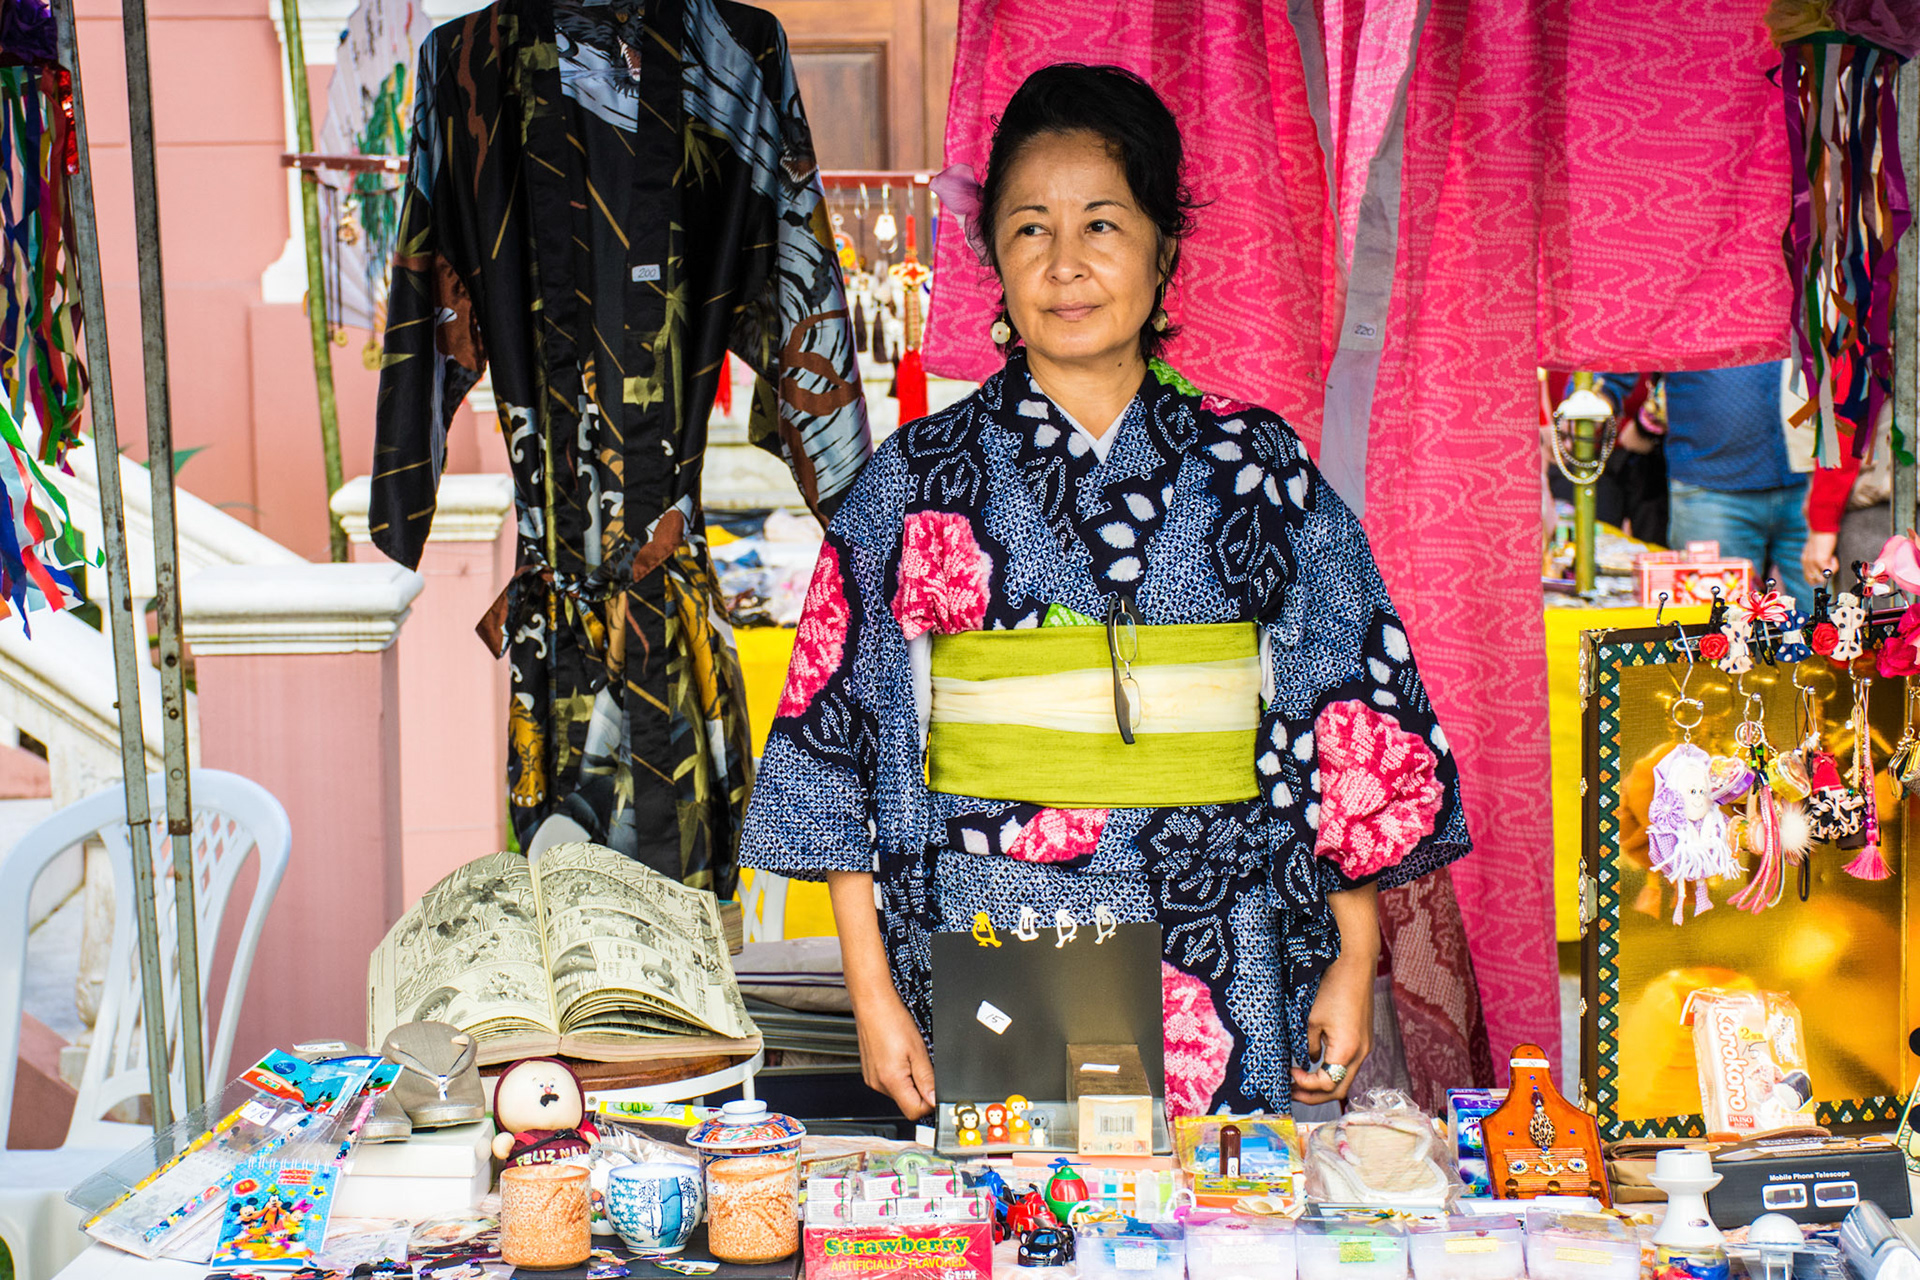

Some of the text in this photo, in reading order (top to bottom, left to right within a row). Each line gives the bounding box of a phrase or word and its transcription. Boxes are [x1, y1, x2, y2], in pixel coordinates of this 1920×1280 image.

[637, 267, 657, 279] 200
[1354, 324, 1375, 336] 220
[985, 1013, 1005, 1024] 15
[516, 1149, 556, 1167] FELIZ
[1769, 1170, 1850, 1182] Mobile Phone Telescope
[824, 1235, 970, 1256] Strawberry
[831, 1256, 967, 1272] ARTIFICIALLY FLAVORED
[944, 1270, 978, 1280] GUM
